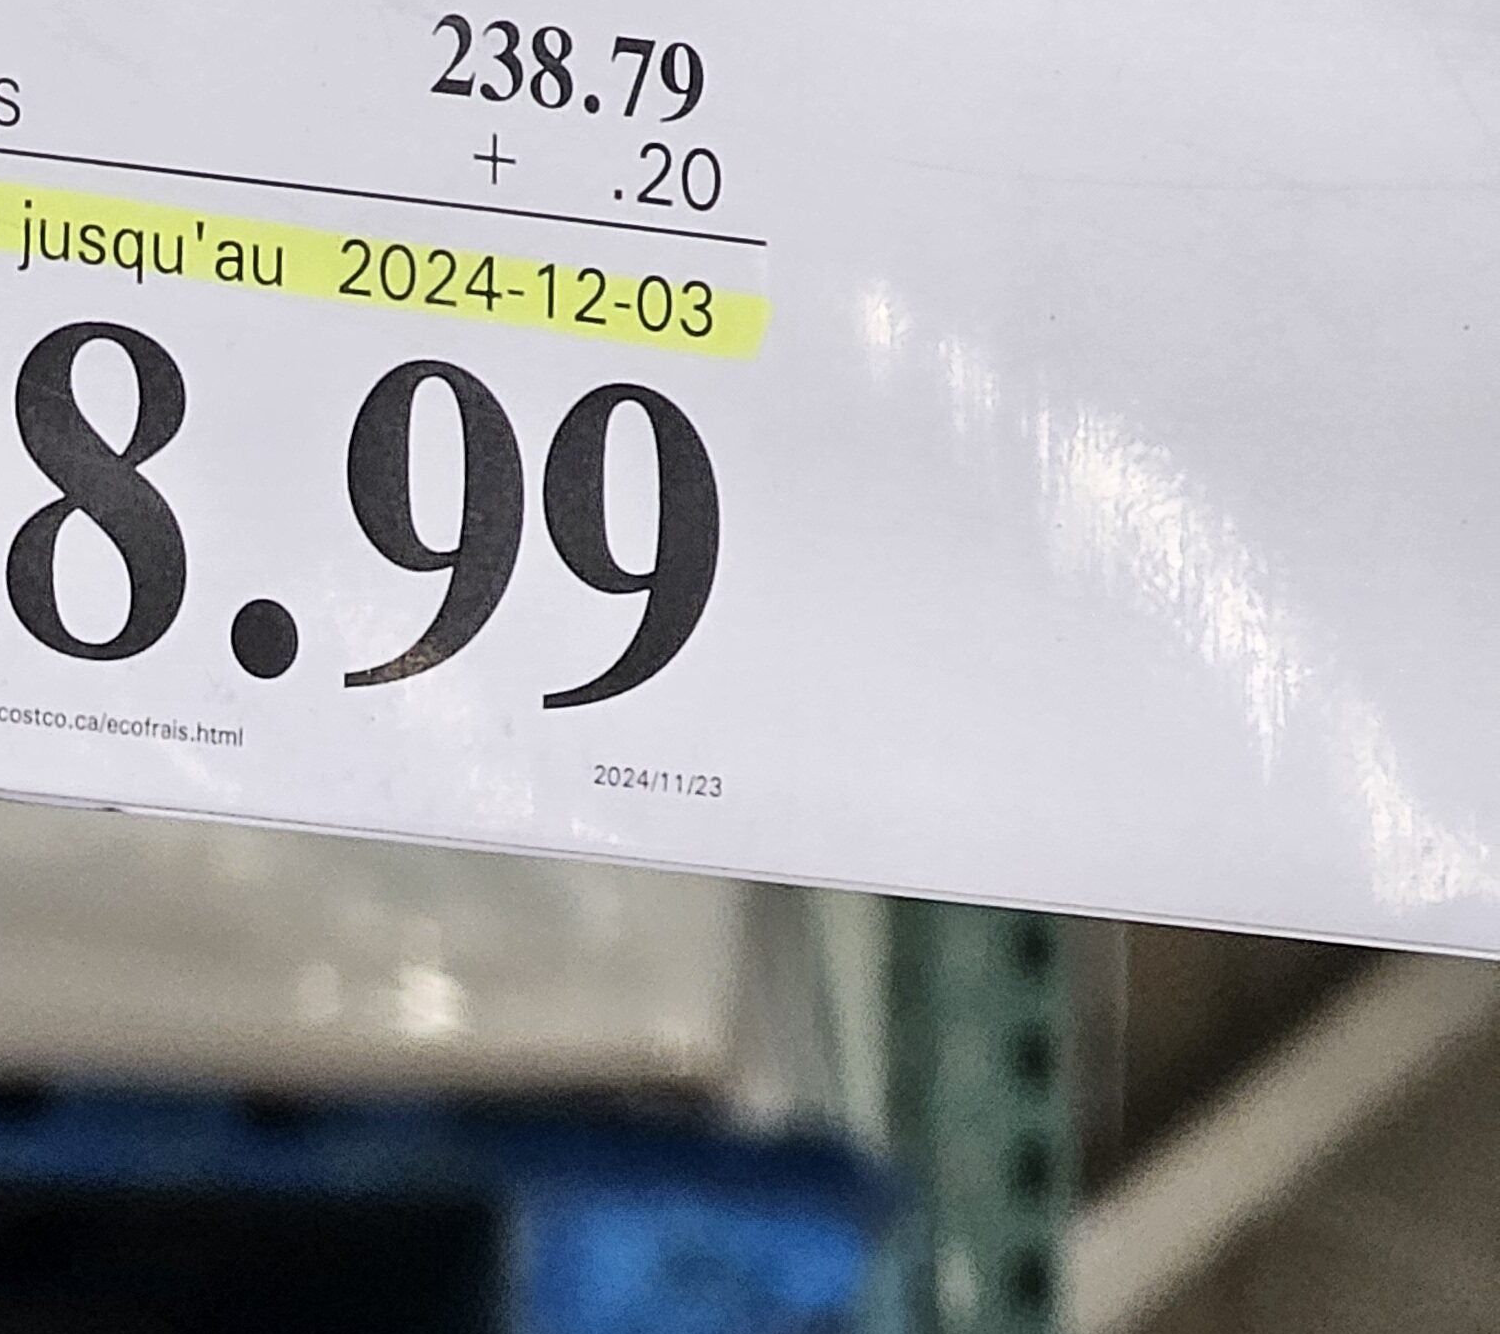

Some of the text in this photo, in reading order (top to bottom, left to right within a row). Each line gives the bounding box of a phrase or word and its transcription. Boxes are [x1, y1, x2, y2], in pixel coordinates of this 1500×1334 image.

[429, 12, 705, 124] 238.79
[612, 141, 723, 213] .20
[17, 199, 284, 288] jusqu'au
[337, 237, 714, 339] 2024-12-03
[593, 764, 723, 798] 2024/11/23
